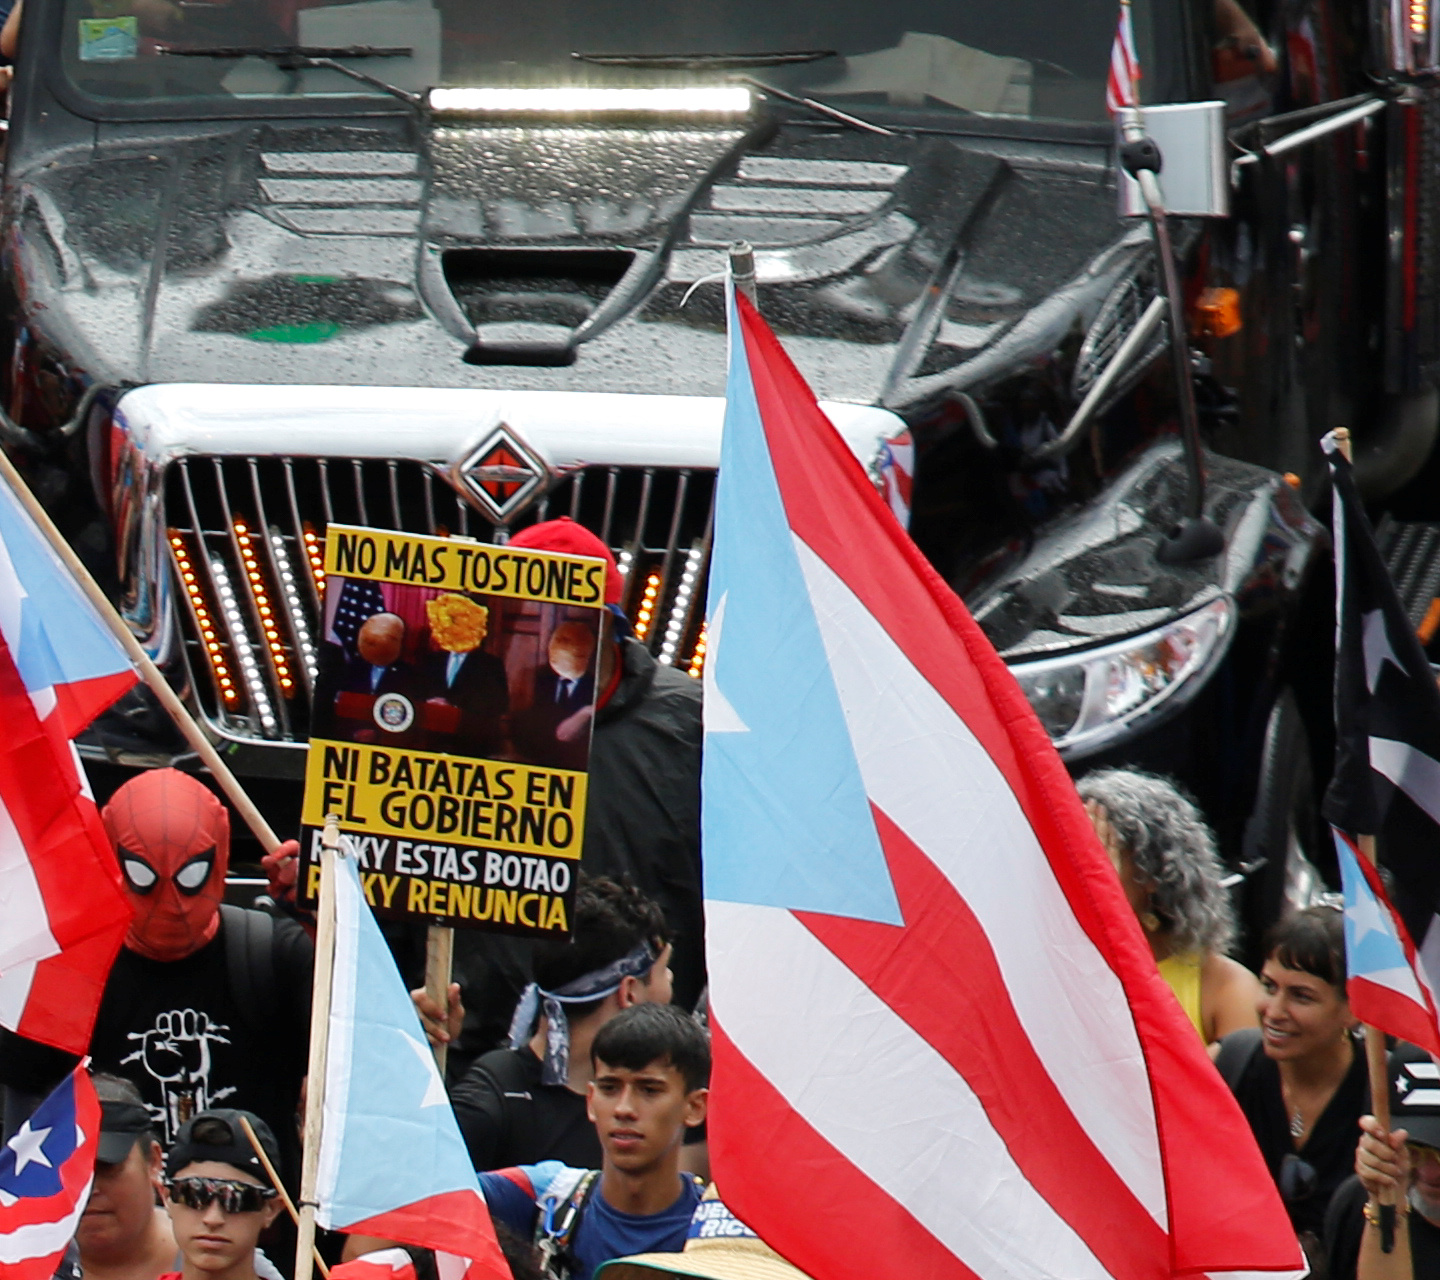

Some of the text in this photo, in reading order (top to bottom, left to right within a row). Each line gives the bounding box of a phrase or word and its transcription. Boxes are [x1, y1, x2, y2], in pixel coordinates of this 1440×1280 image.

[336, 533, 603, 604] NO MAS TOSTONES
[323, 746, 575, 809] NI BATATAS EN
[323, 781, 574, 849] EL GOBIERNO
[395, 843, 478, 882] ESTAS
[484, 854, 571, 892] BOTAO
[408, 878, 569, 932] RENUNCIA
